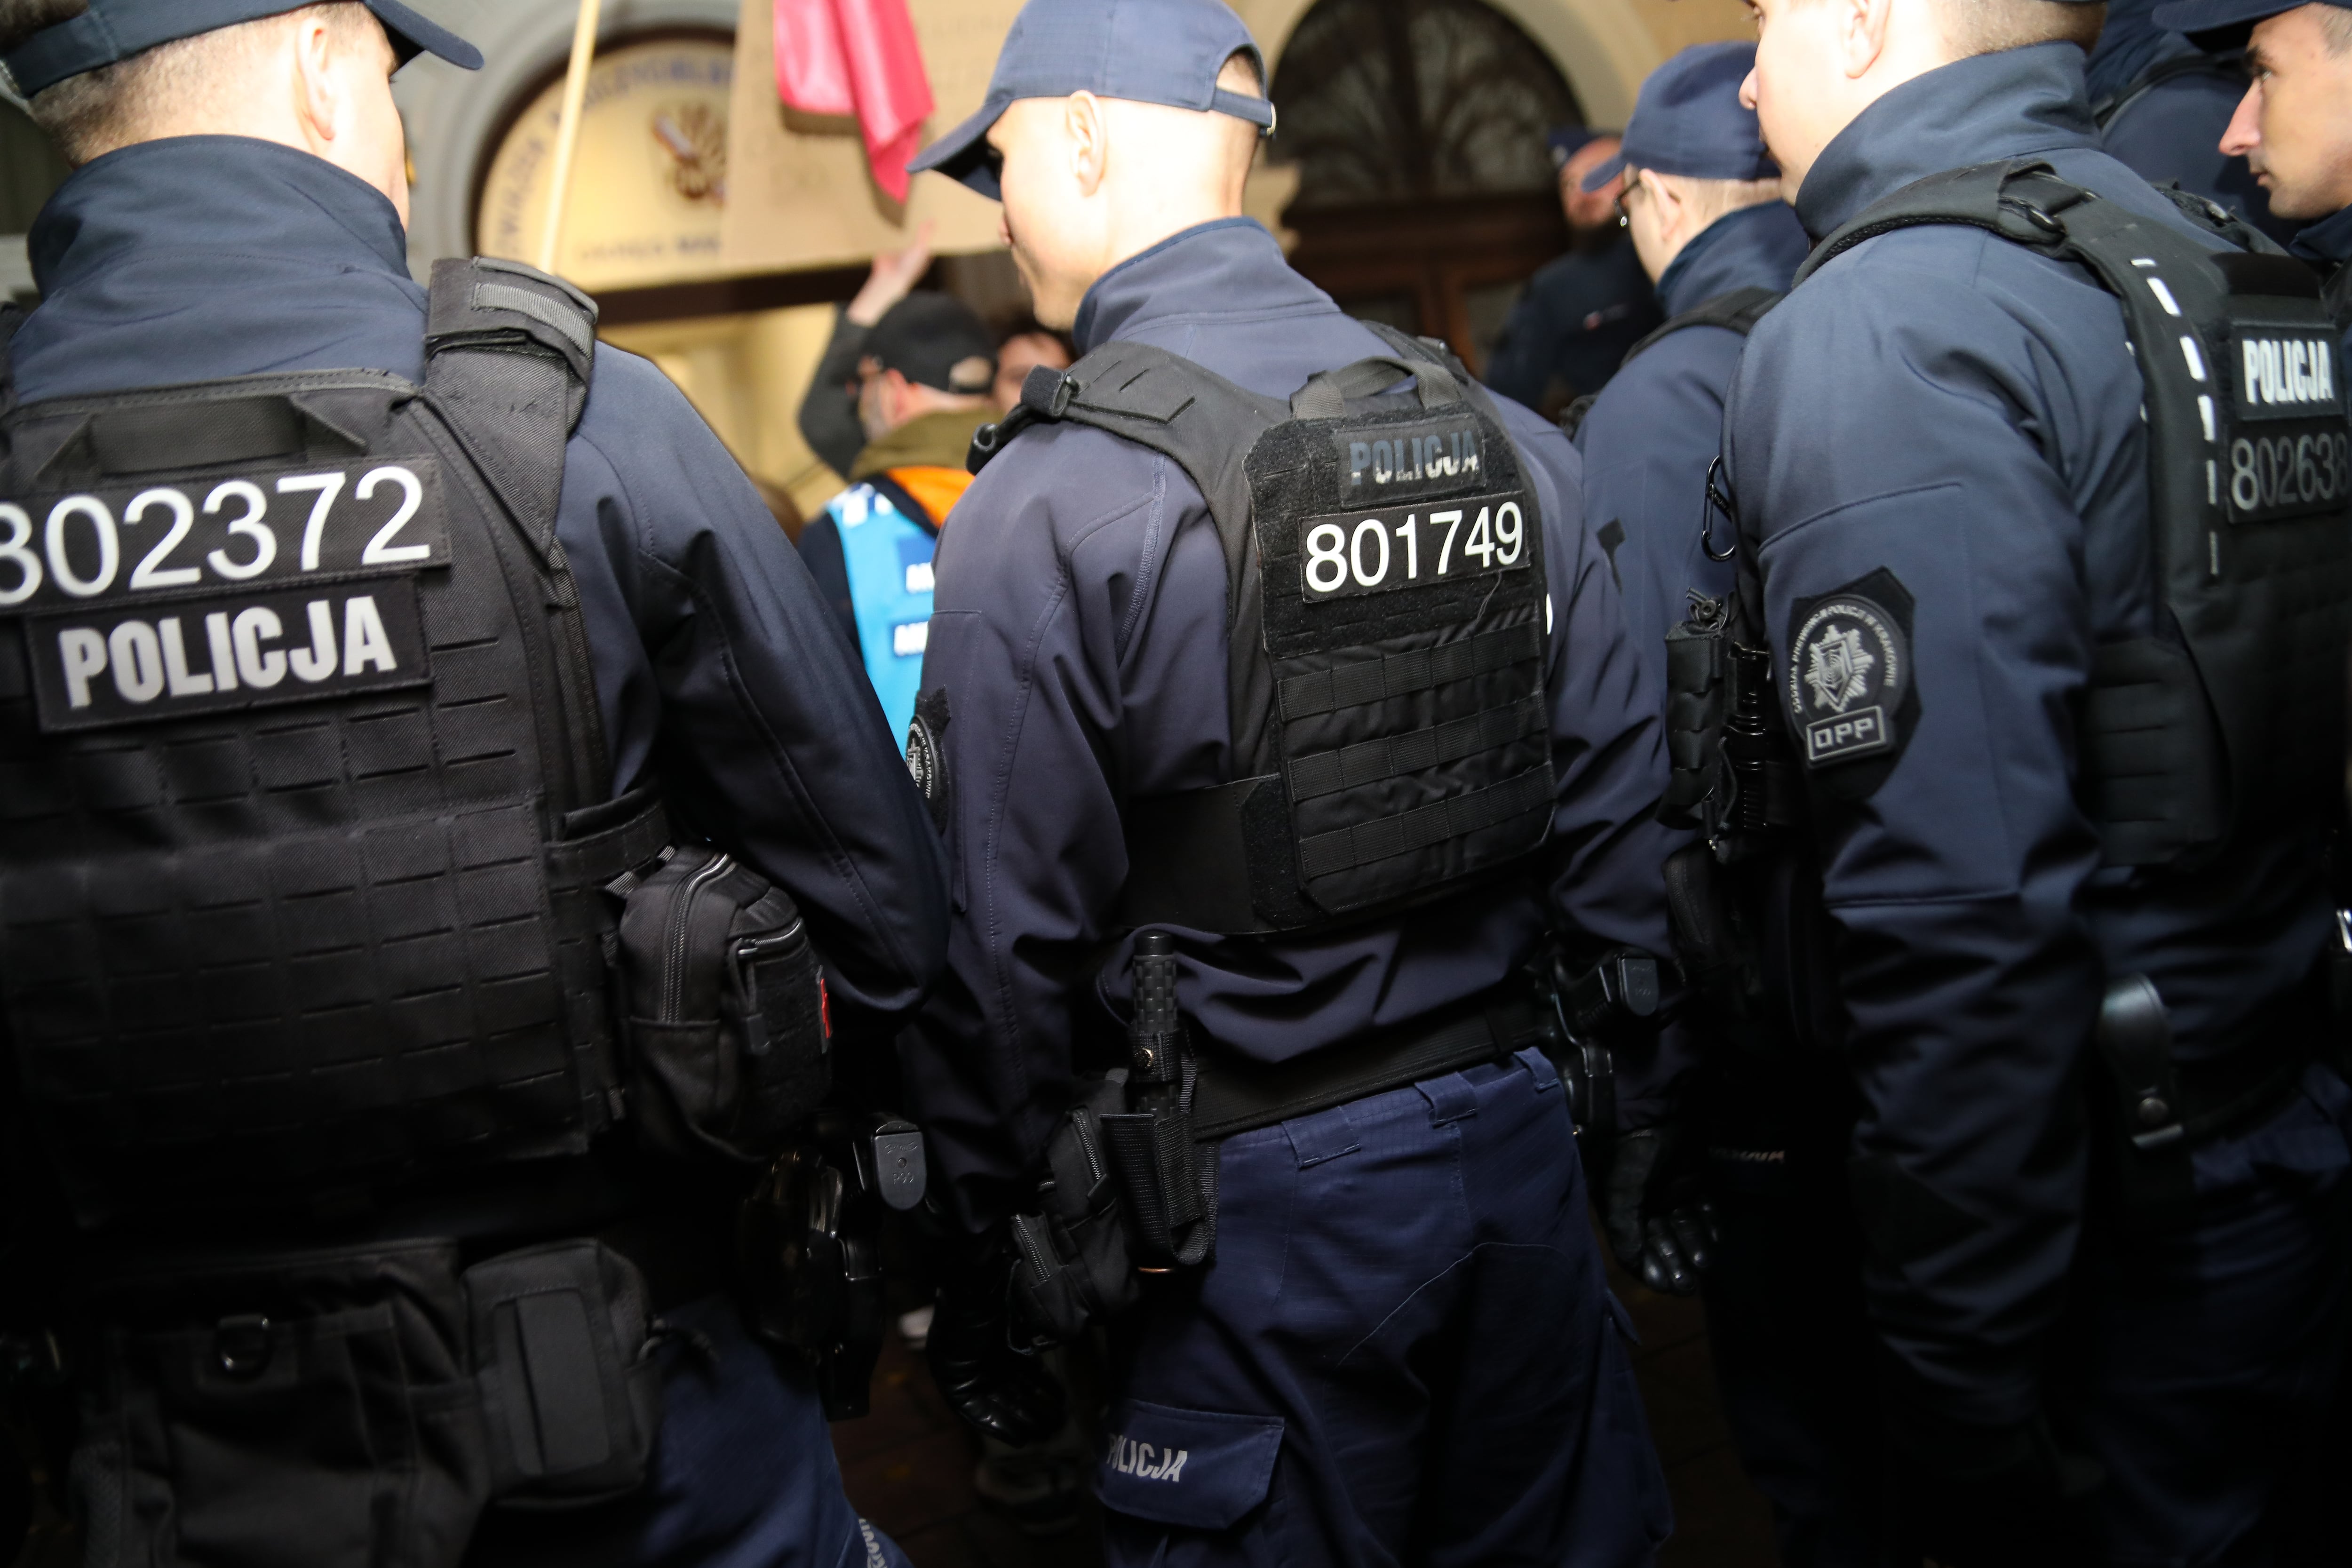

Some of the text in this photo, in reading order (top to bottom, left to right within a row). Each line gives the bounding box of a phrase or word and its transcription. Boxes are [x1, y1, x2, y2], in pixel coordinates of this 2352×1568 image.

[2242, 340, 2334, 404] POLICJA
[1349, 430, 1479, 485] POLICJA
[2231, 433, 2351, 511] 802638
[1305, 501, 1523, 592] 801749
[59, 596, 397, 709] POLICJA
[1814, 718, 1874, 749] OPP
